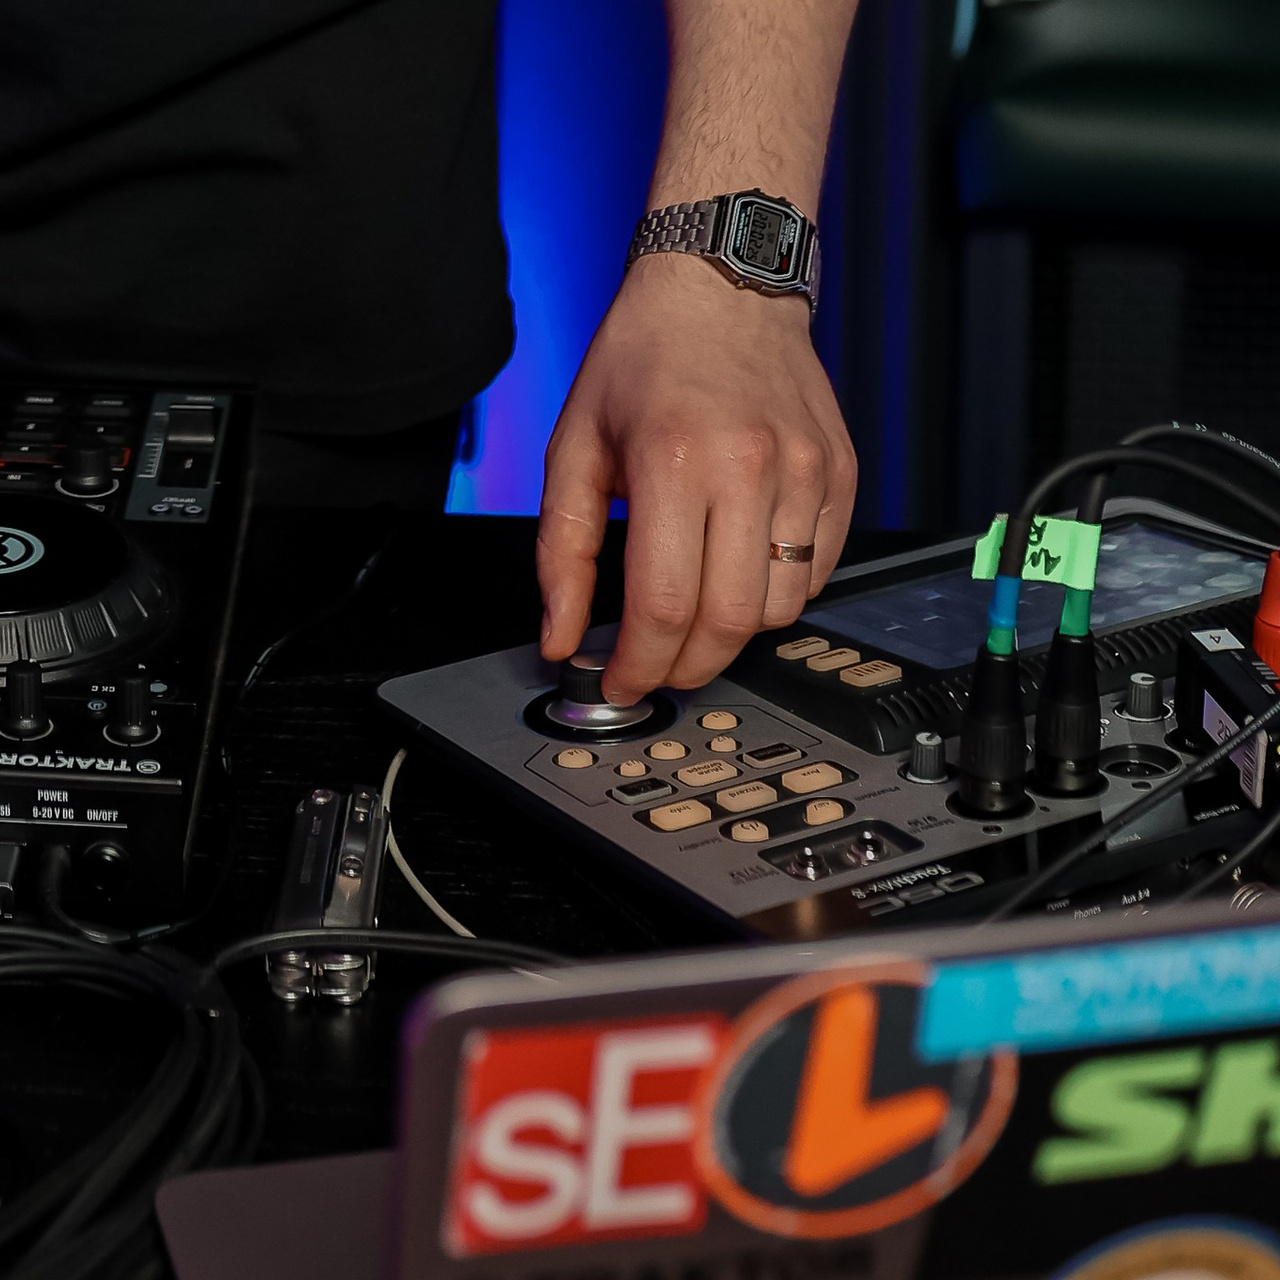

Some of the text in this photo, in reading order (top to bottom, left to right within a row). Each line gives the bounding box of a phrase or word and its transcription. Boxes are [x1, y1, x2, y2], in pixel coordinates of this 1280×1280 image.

[1209, 633, 1222, 645] 4
[0, 750, 132, 773] TRAKTOR
[37, 788, 69, 803] POWER
[54, 807, 61, 819] V
[62, 807, 75, 820] DC
[86, 808, 119, 822] ON/OFF
[850, 862, 953, 900] TouchMix-8
[857, 869, 986, 917] QSC
[1073, 904, 1102, 920] Phones
